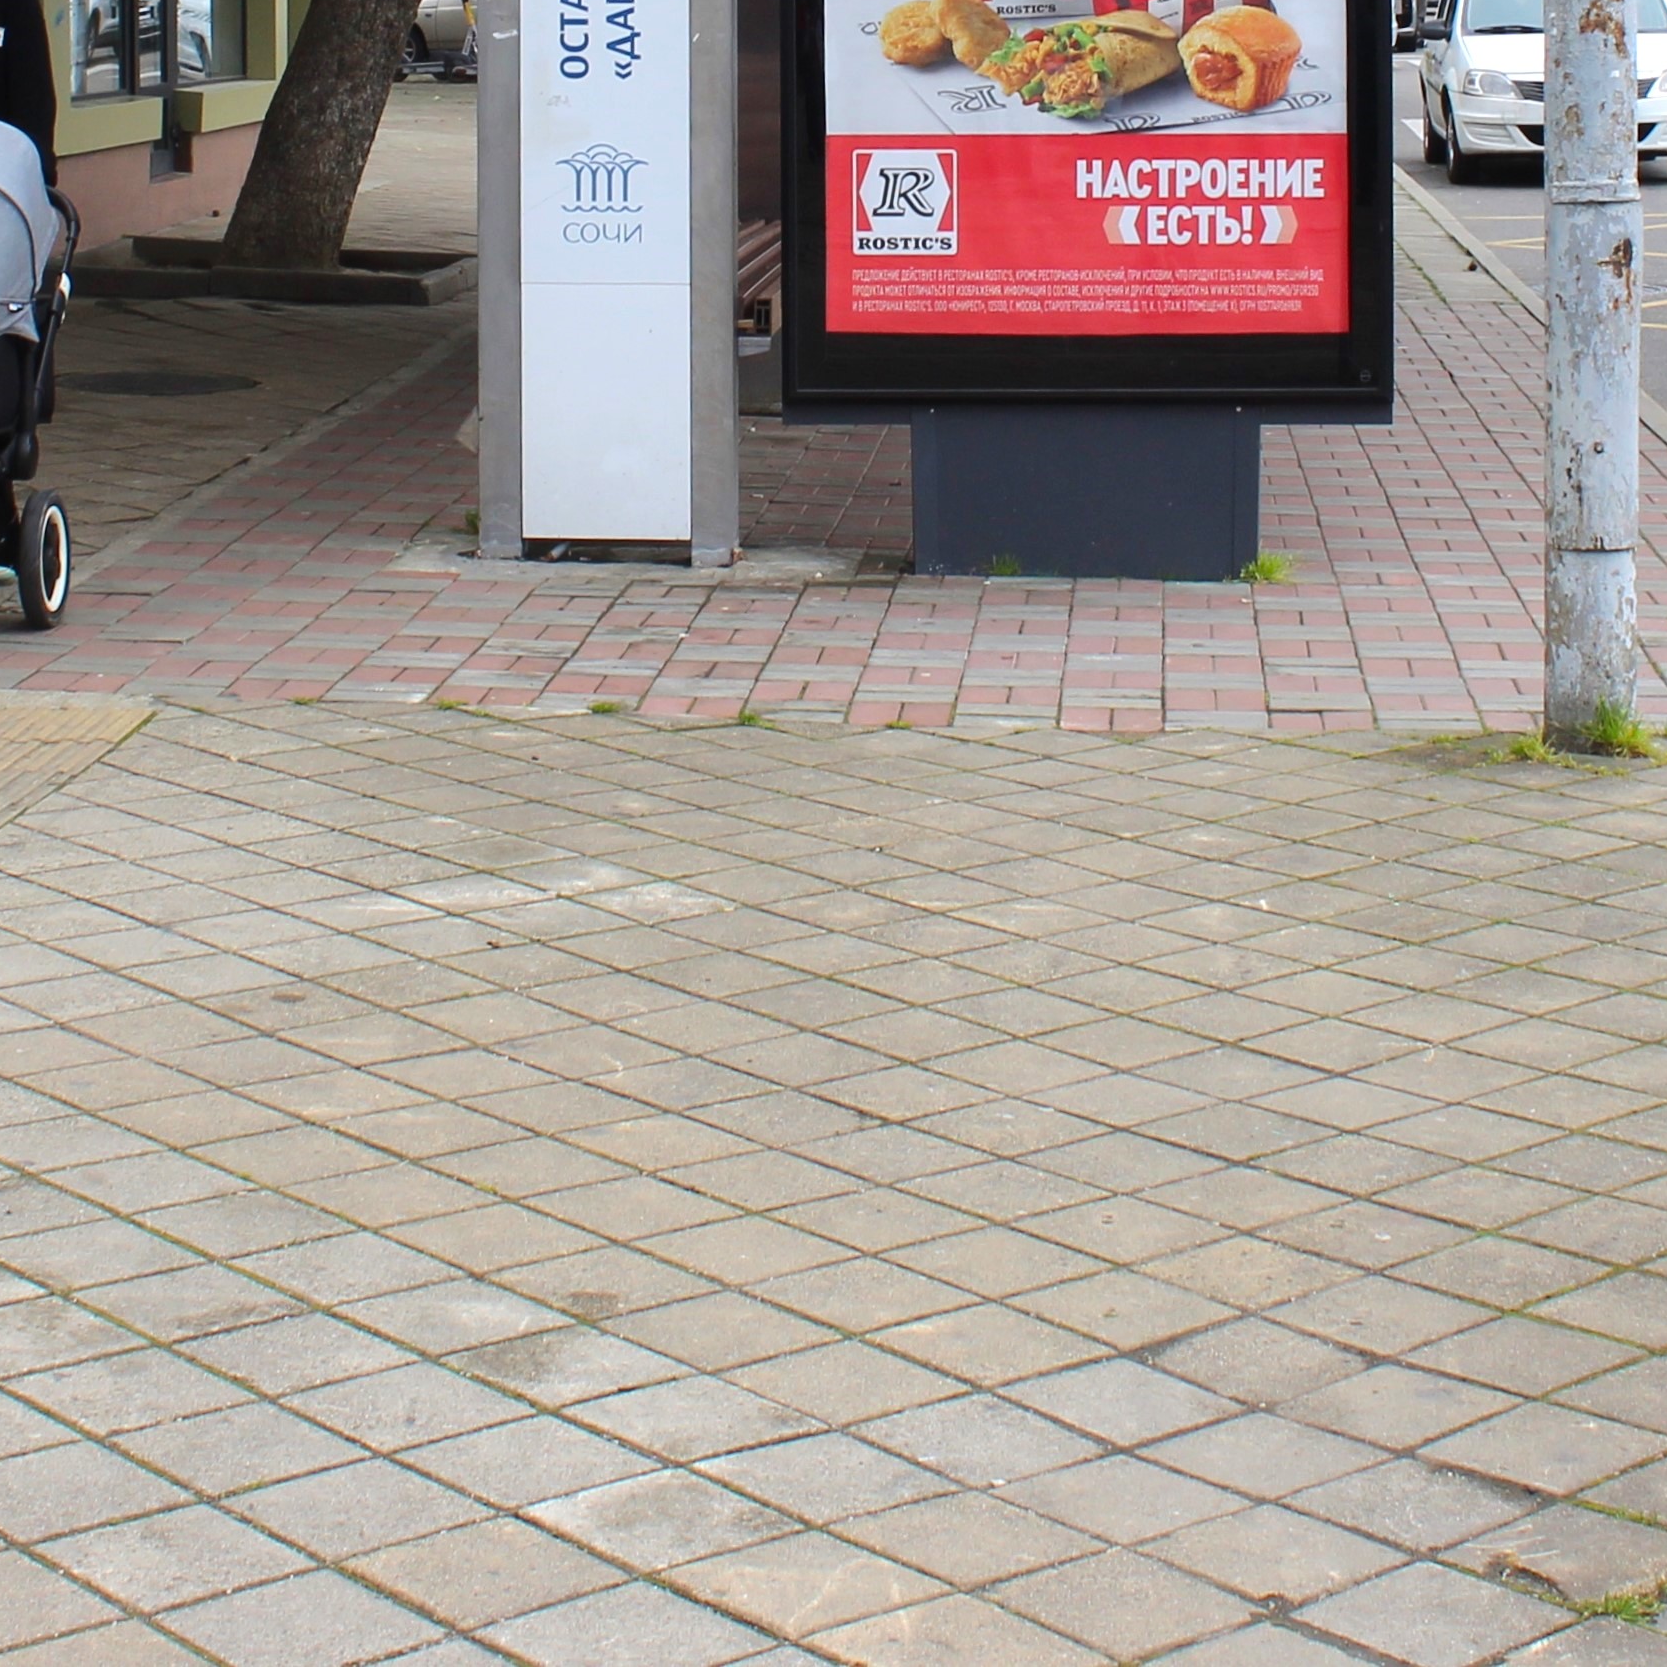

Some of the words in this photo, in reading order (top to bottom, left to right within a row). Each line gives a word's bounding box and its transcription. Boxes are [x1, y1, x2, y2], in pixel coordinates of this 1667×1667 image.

[996, 3, 1057, 15] ROSTIC'S
[1076, 157, 1325, 200] НАСТРОЕНИЕ
[562, 221, 643, 244] СОЧИ
[1146, 205, 1254, 246] ЕСТЬ!
[858, 236, 953, 251] ROSTIC'S
